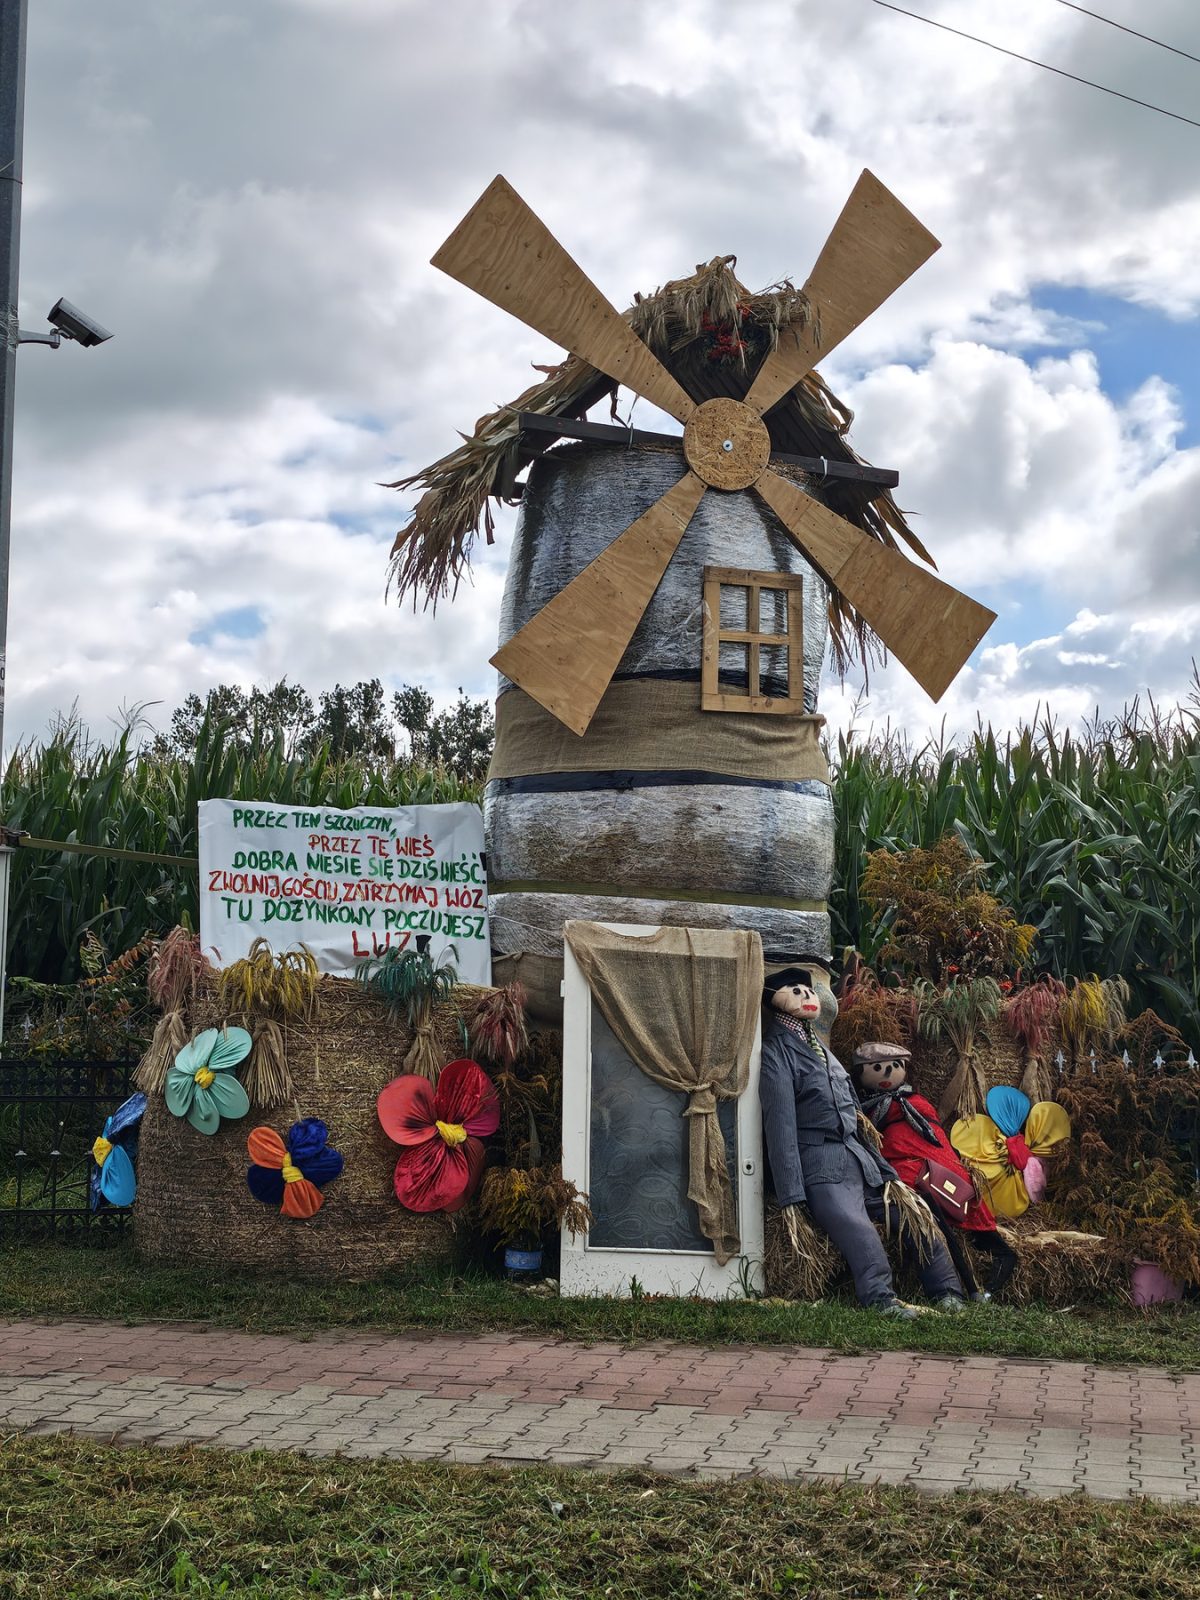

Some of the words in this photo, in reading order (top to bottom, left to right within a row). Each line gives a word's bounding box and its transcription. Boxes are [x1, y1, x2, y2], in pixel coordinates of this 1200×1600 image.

[232, 809, 288, 829] PRZEZ
[291, 811, 321, 828] TEN
[308, 834, 361, 854] PRZEZ
[396, 834, 435, 857] WIEŚ
[231, 850, 298, 872] DOBRA
[306, 852, 362, 876] NIESIE
[368, 857, 394, 880] SIĘ
[342, 879, 438, 908] ZATRZYMAJ
[220, 896, 253, 922] TU
[382, 907, 486, 940] POCZUJESZ
